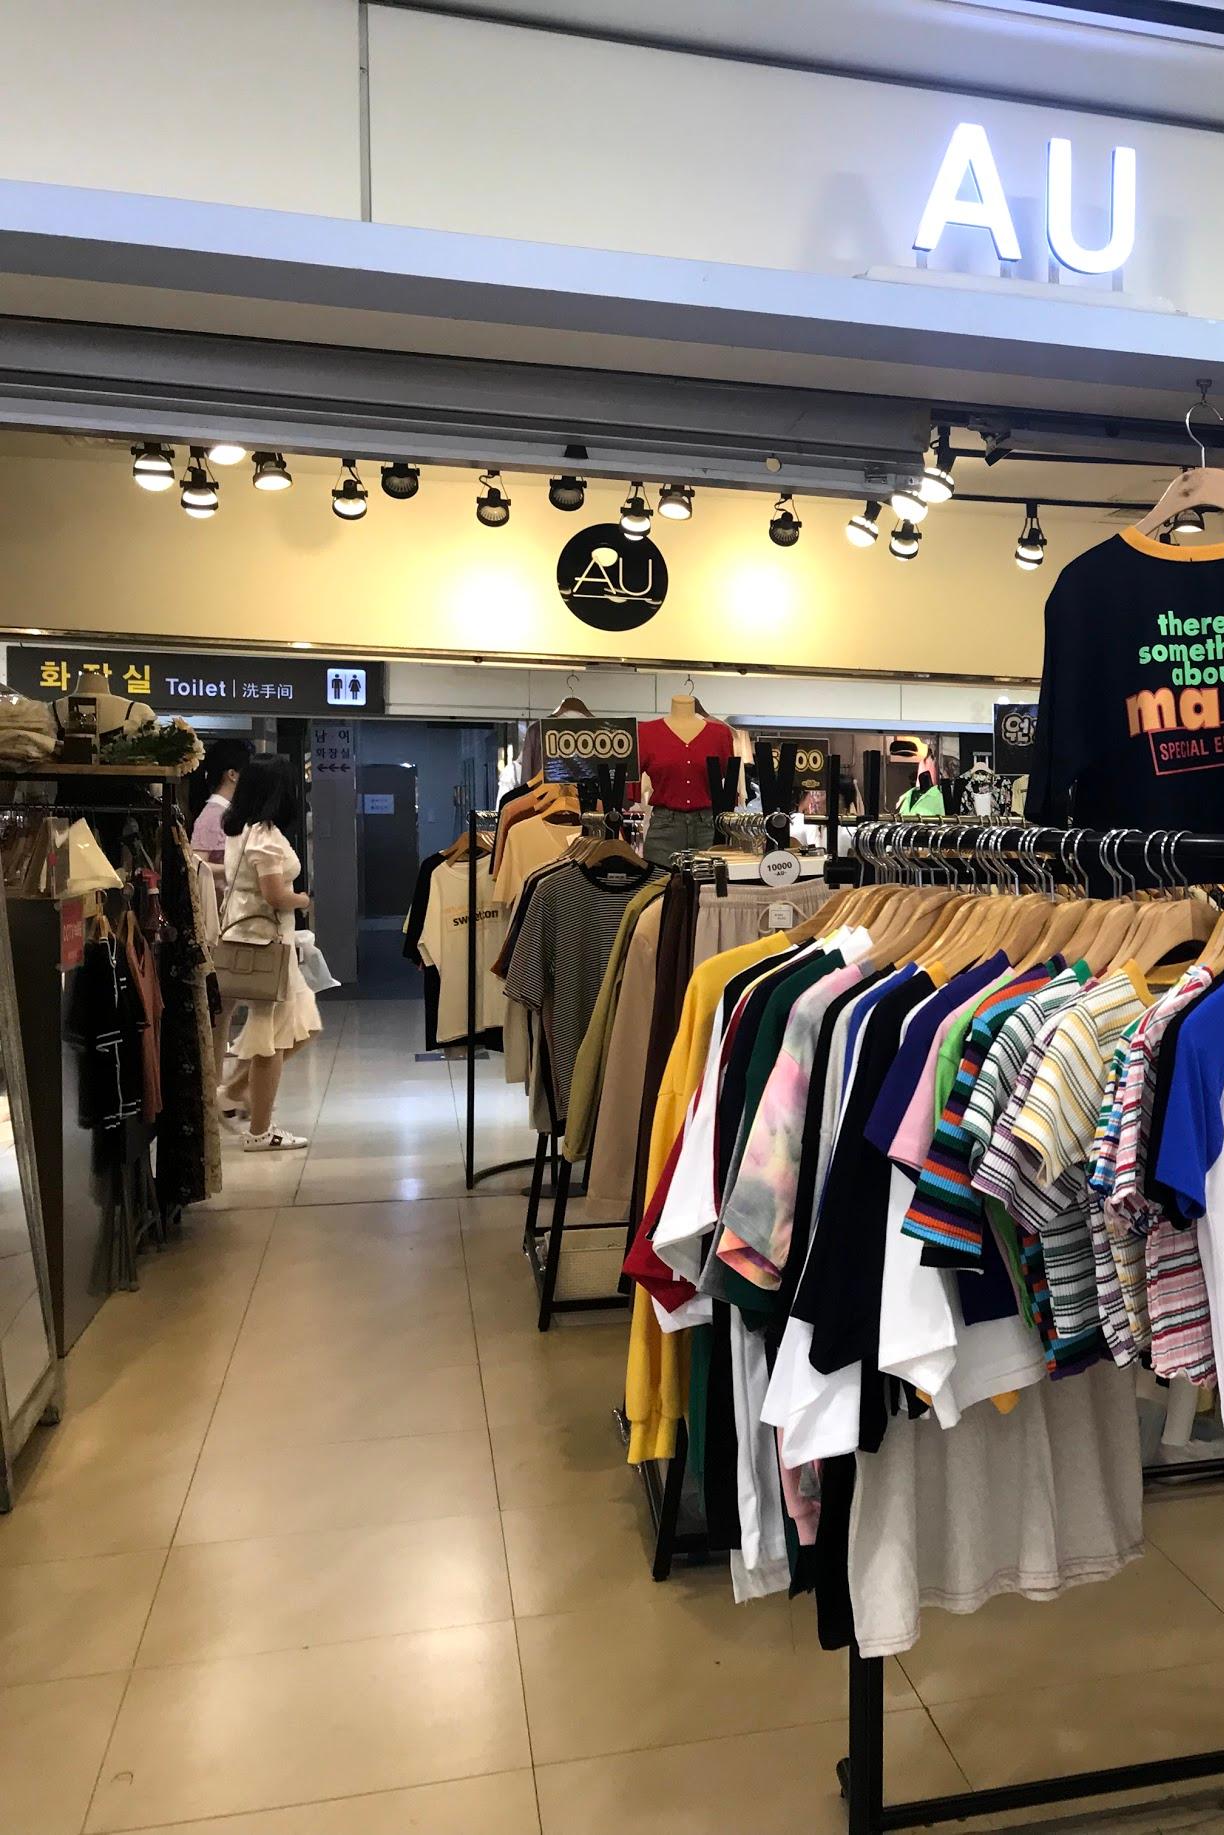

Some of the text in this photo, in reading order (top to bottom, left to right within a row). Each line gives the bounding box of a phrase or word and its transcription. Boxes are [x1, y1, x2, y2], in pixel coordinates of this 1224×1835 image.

[912, 122, 1136, 275] AU
[573, 556, 653, 596] AU
[165, 677, 226, 698] Toilet
[242, 682, 294, 700] 洗手间
[546, 730, 632, 758] 10000
[1159, 739, 1209, 761] SPECIAL
[767, 861, 793, 872] 10000
